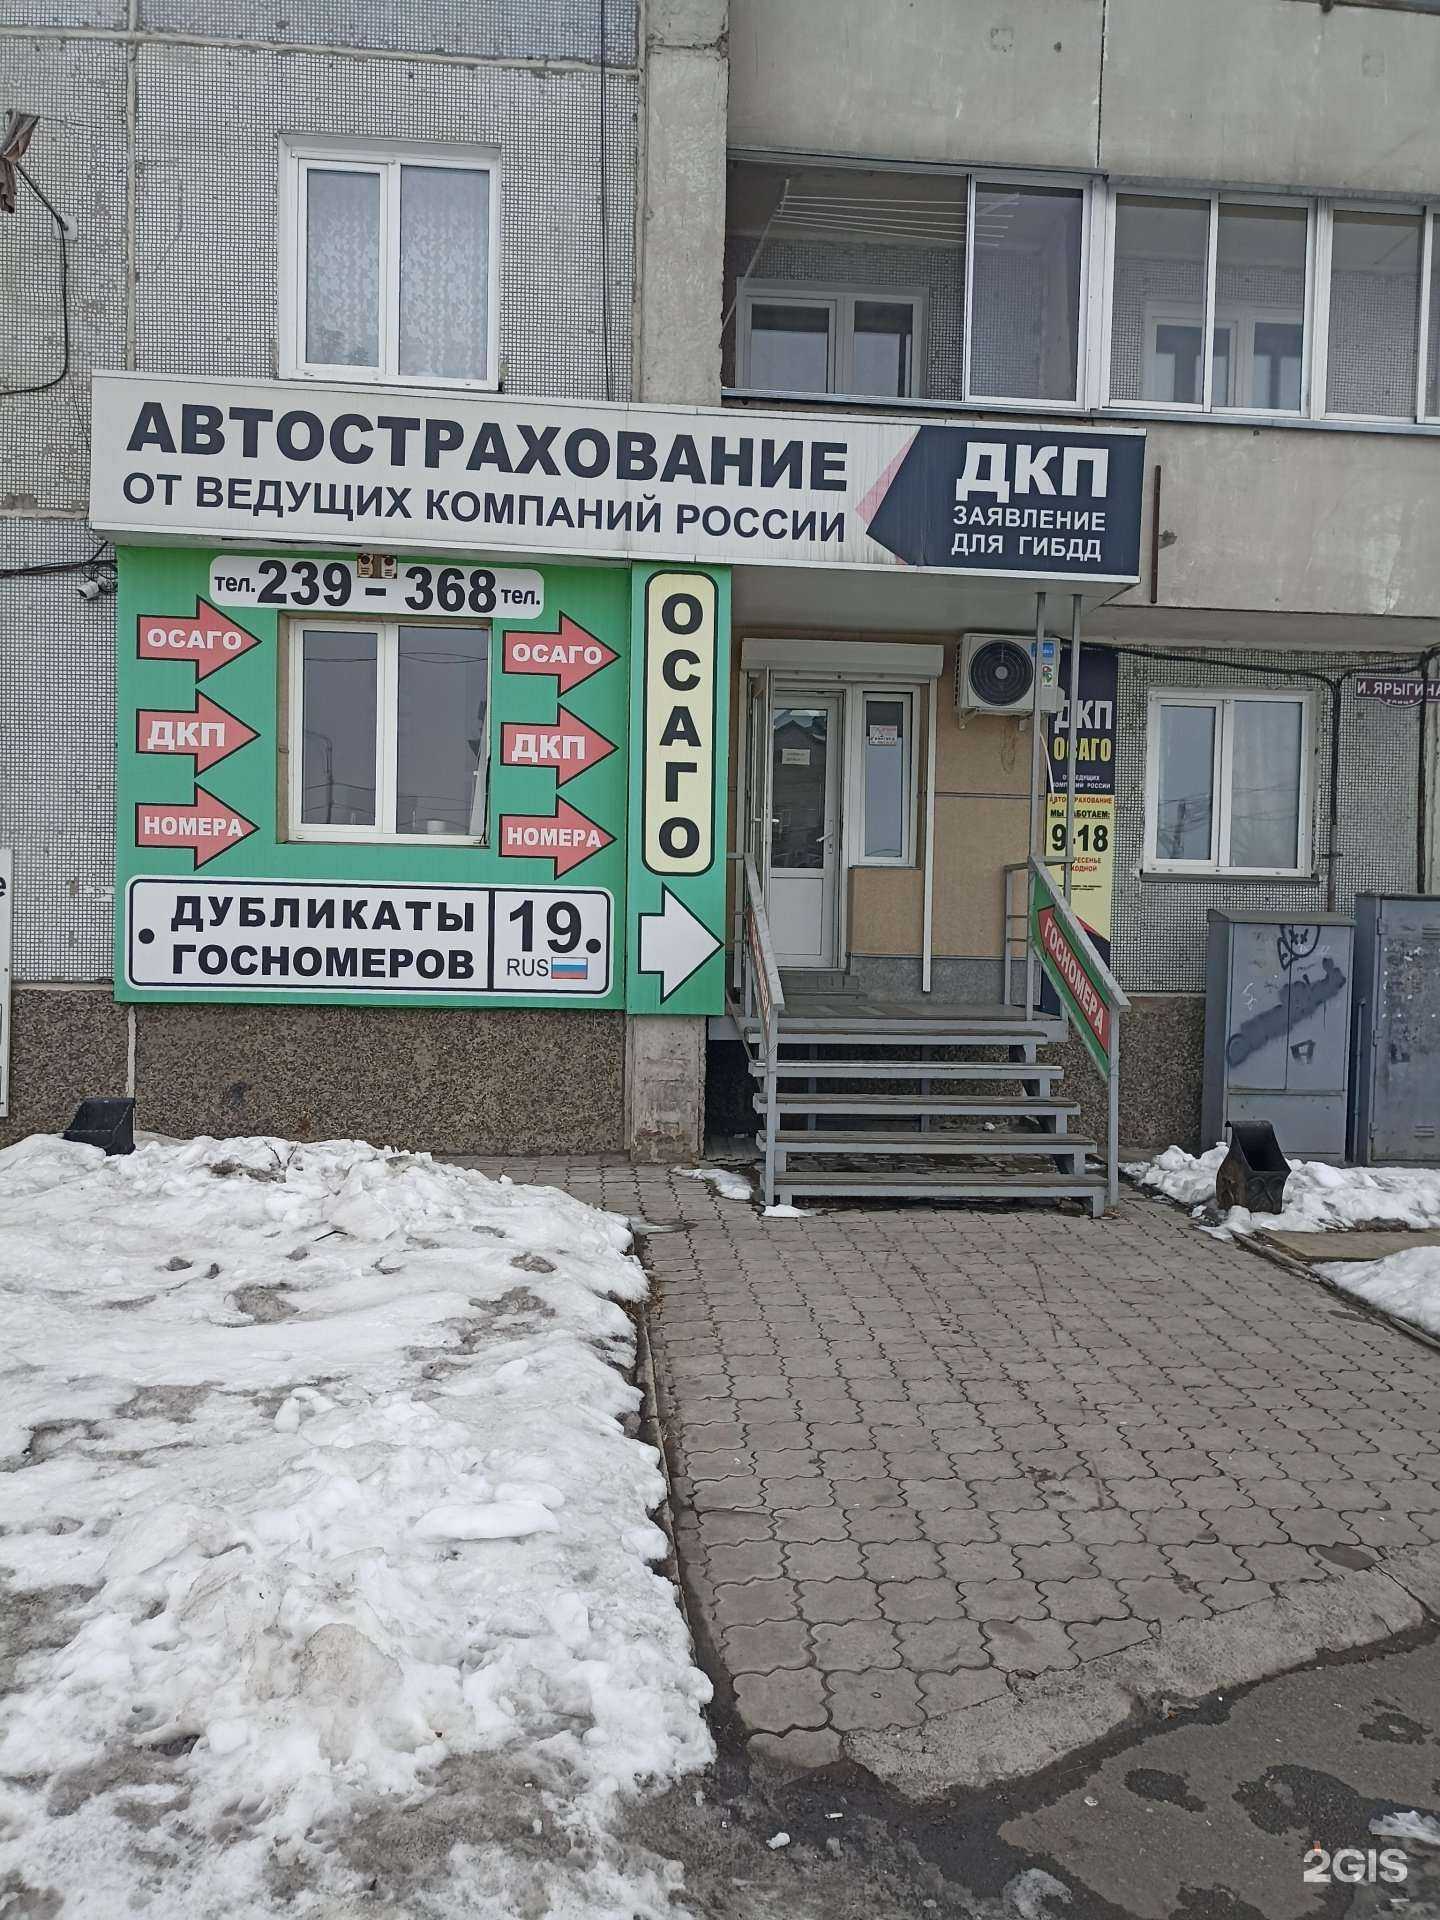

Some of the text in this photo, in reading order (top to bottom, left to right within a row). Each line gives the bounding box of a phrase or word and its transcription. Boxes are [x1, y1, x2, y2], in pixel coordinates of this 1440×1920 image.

[126, 401, 848, 492] АВТОСТРАХОВАНИЕ
[956, 442, 1109, 503] ДКП
[122, 472, 845, 543] ОТ ВЕДУЩИХ КОМПАНИЙ РОССИИ
[953, 505, 1106, 531] ЗАЯВЛЕНИЕ
[951, 533, 1102, 562] ДЛЯ ГИБДД
[214, 574, 256, 594] тел.
[501, 588, 541, 606] тел.
[146, 627, 243, 651] ОСАГО
[511, 642, 603, 666] ОСАГО
[1357, 681, 1371, 695] И.
[658, 592, 704, 859] ОСАГО
[1054, 700, 1113, 734] ДКП
[146, 719, 226, 751] ДКП
[511, 733, 586, 761] ДКП
[1053, 737, 1112, 762] ОАГО
[143, 816, 244, 837] НОМЕРА
[506, 826, 602, 848] НОМЕРА
[171, 895, 475, 933] ДУБЛИКАТЫ
[172, 943, 475, 979] ГОСНОМЕРОВ
[506, 957, 550, 978] RUS
[1045, 918, 1104, 1034] ГОСНОМЕРА
